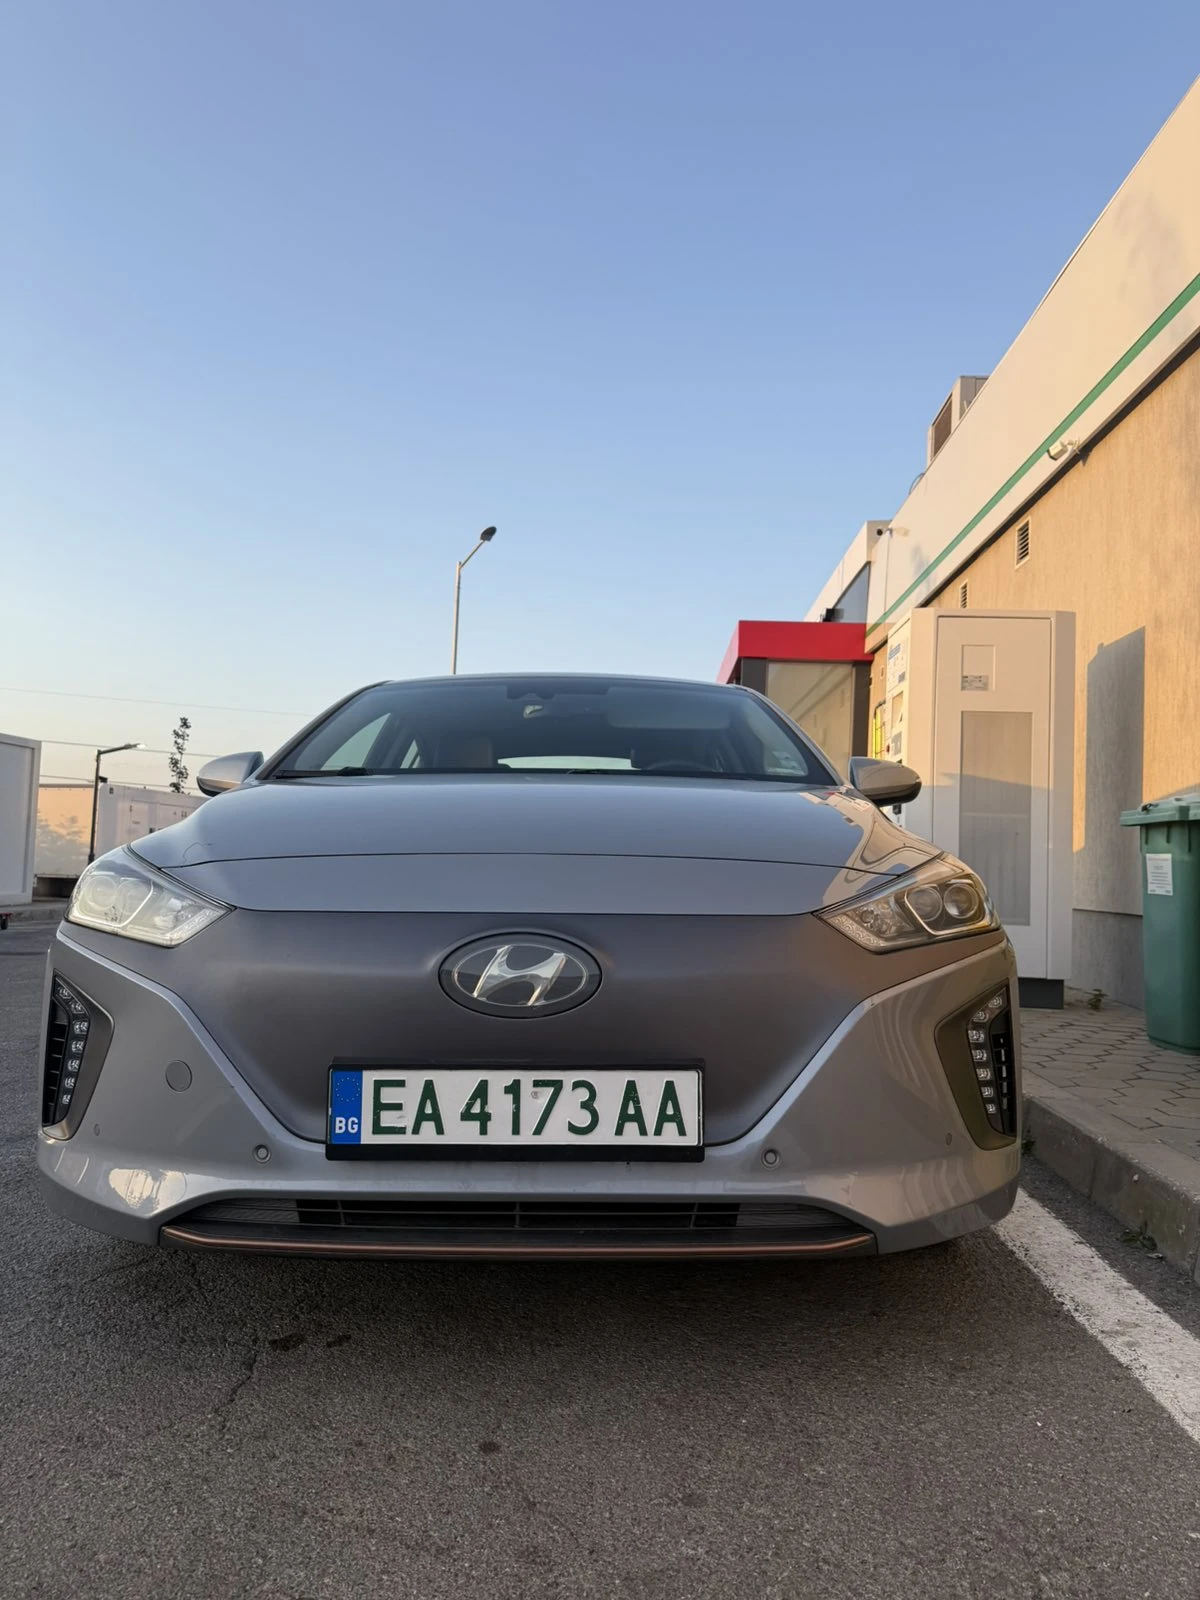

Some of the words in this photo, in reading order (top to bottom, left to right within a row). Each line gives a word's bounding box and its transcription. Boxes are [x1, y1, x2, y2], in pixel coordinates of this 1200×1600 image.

[335, 1116, 359, 1134] BG
[372, 1079, 444, 1136] EA
[459, 1079, 599, 1136] 4173
[614, 1079, 687, 1137] AA
